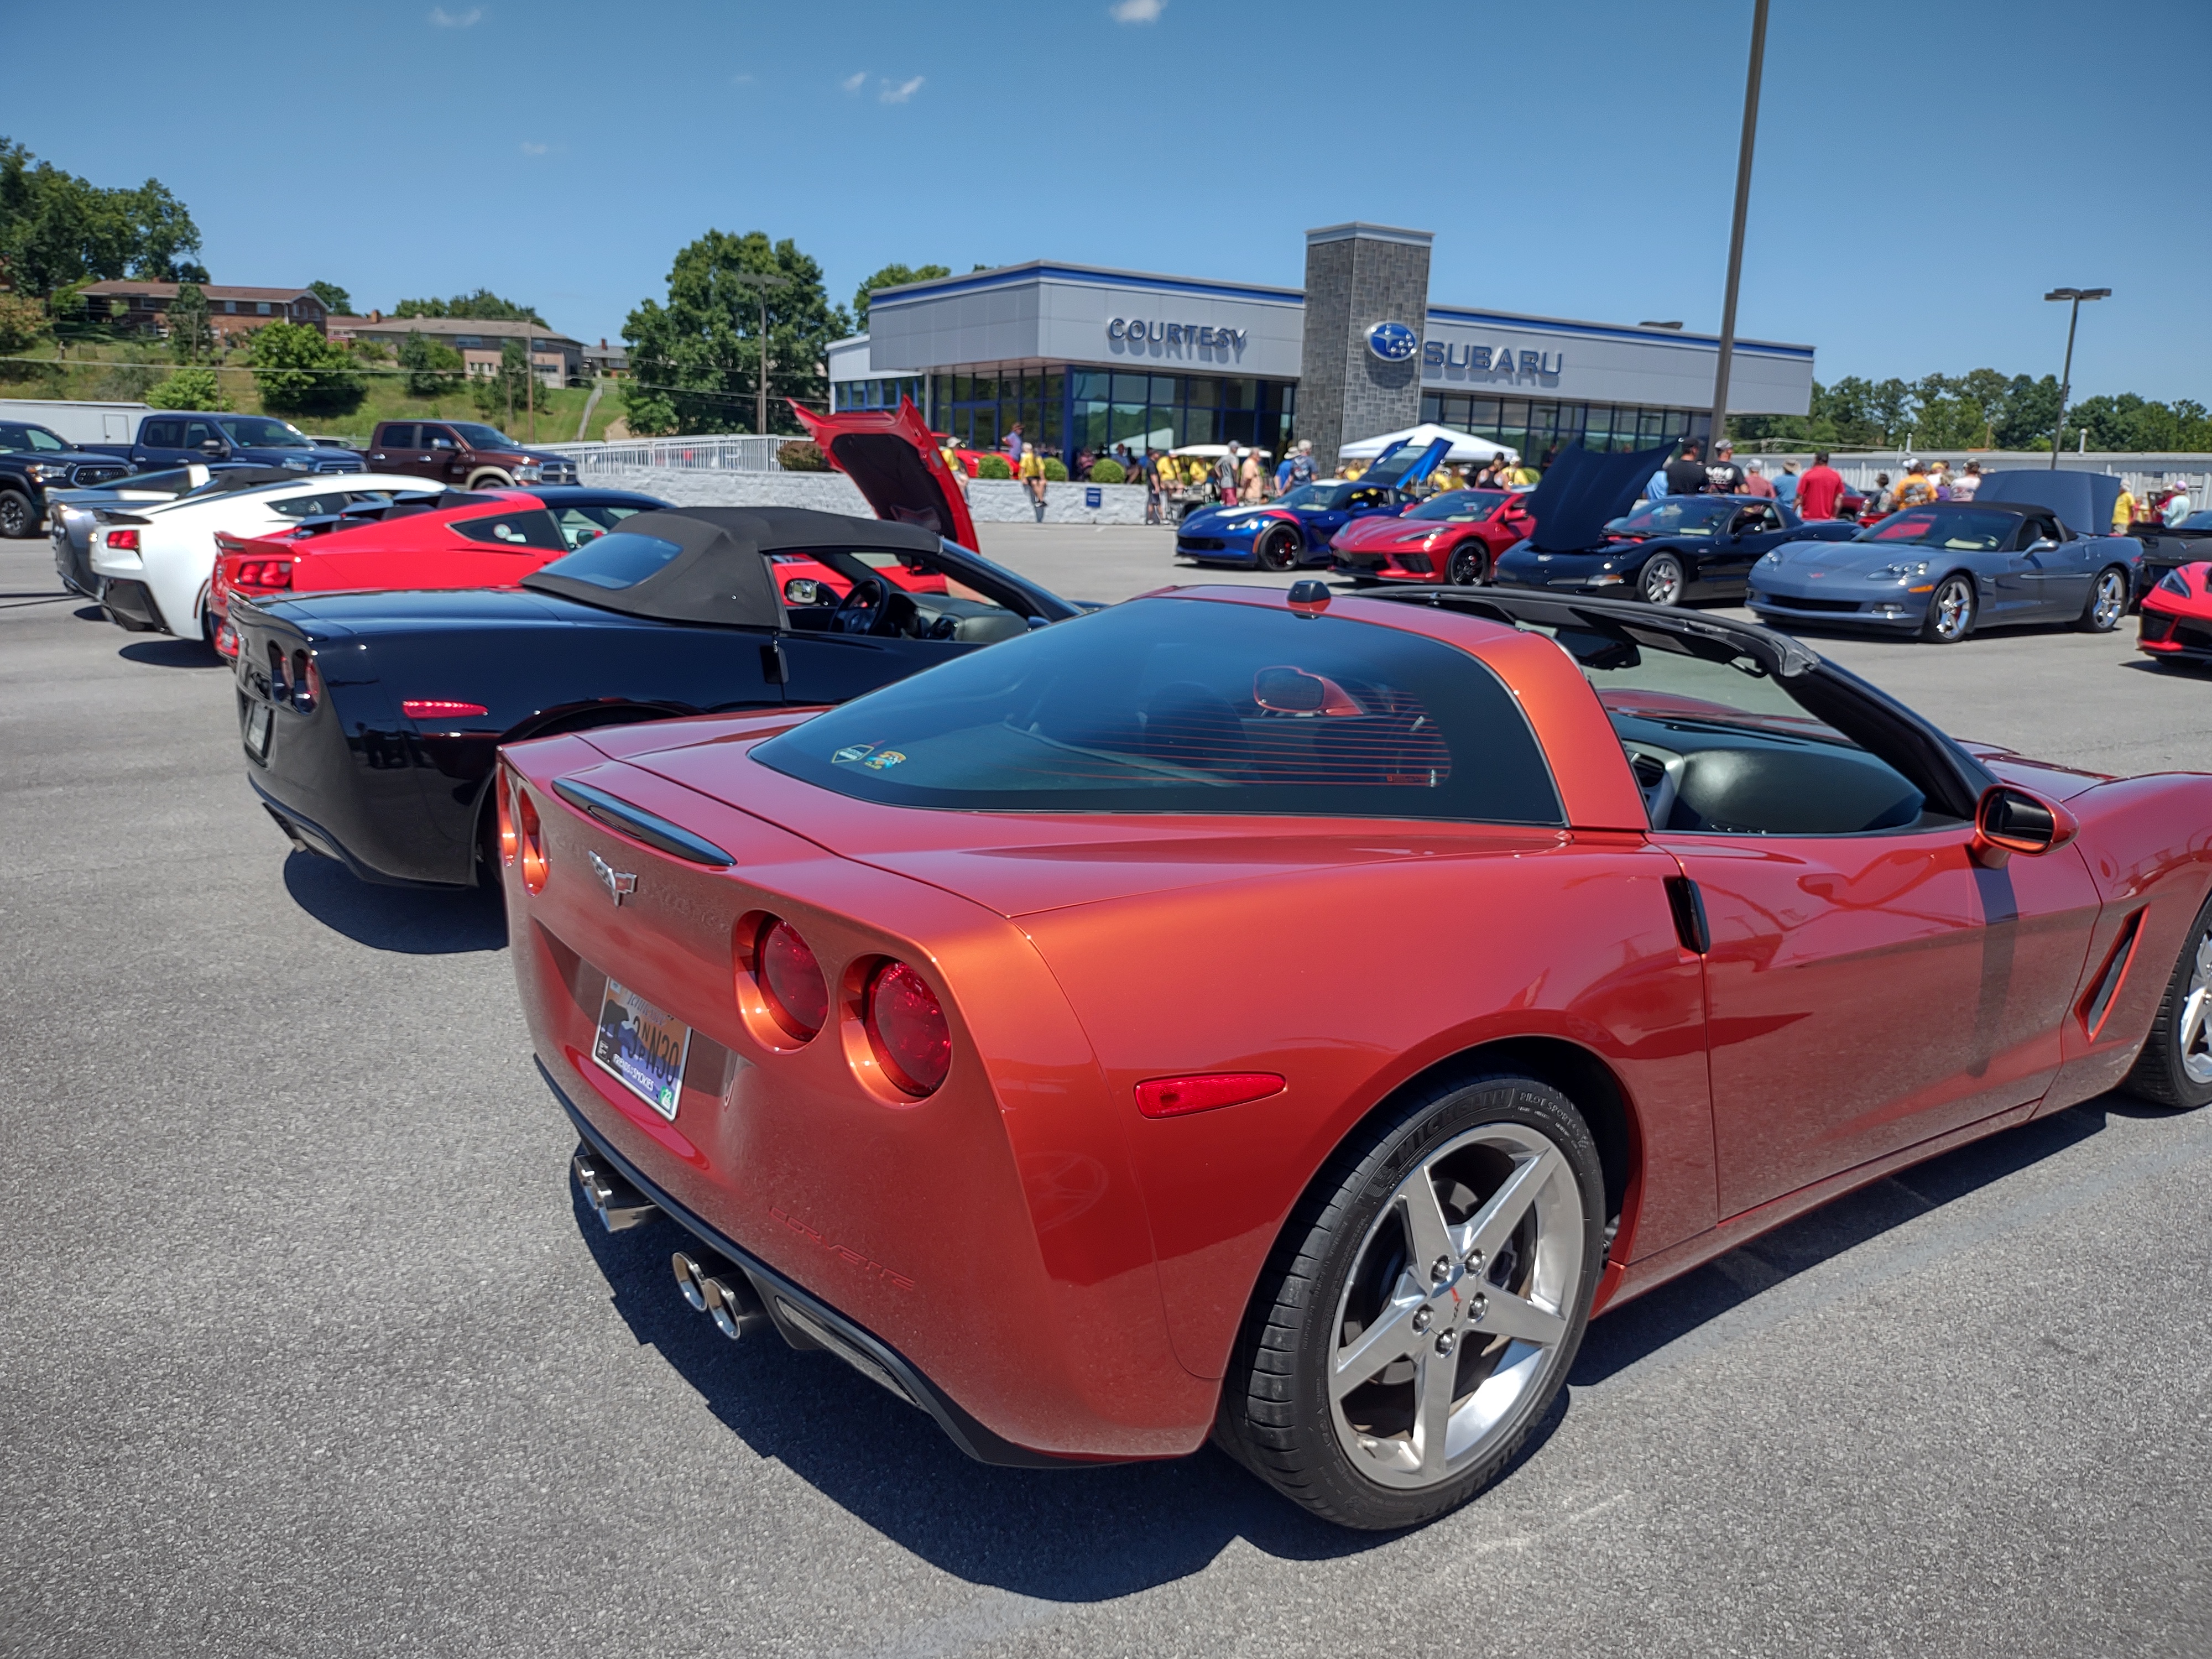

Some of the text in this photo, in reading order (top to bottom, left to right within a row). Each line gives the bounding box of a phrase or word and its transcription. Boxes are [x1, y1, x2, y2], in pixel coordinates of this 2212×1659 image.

[1107, 317, 1247, 351] COURTESY
[1423, 340, 1562, 375] SUBARU
[633, 1067, 654, 1092] SMOKIES
[665, 1088, 672, 1099] 22
[1519, 1091, 1547, 1107] PILOT
[1547, 1101, 1573, 1125] SPORT
[1397, 1088, 1510, 1164] MICHELIN
[769, 1204, 916, 1291] CORVETTE
